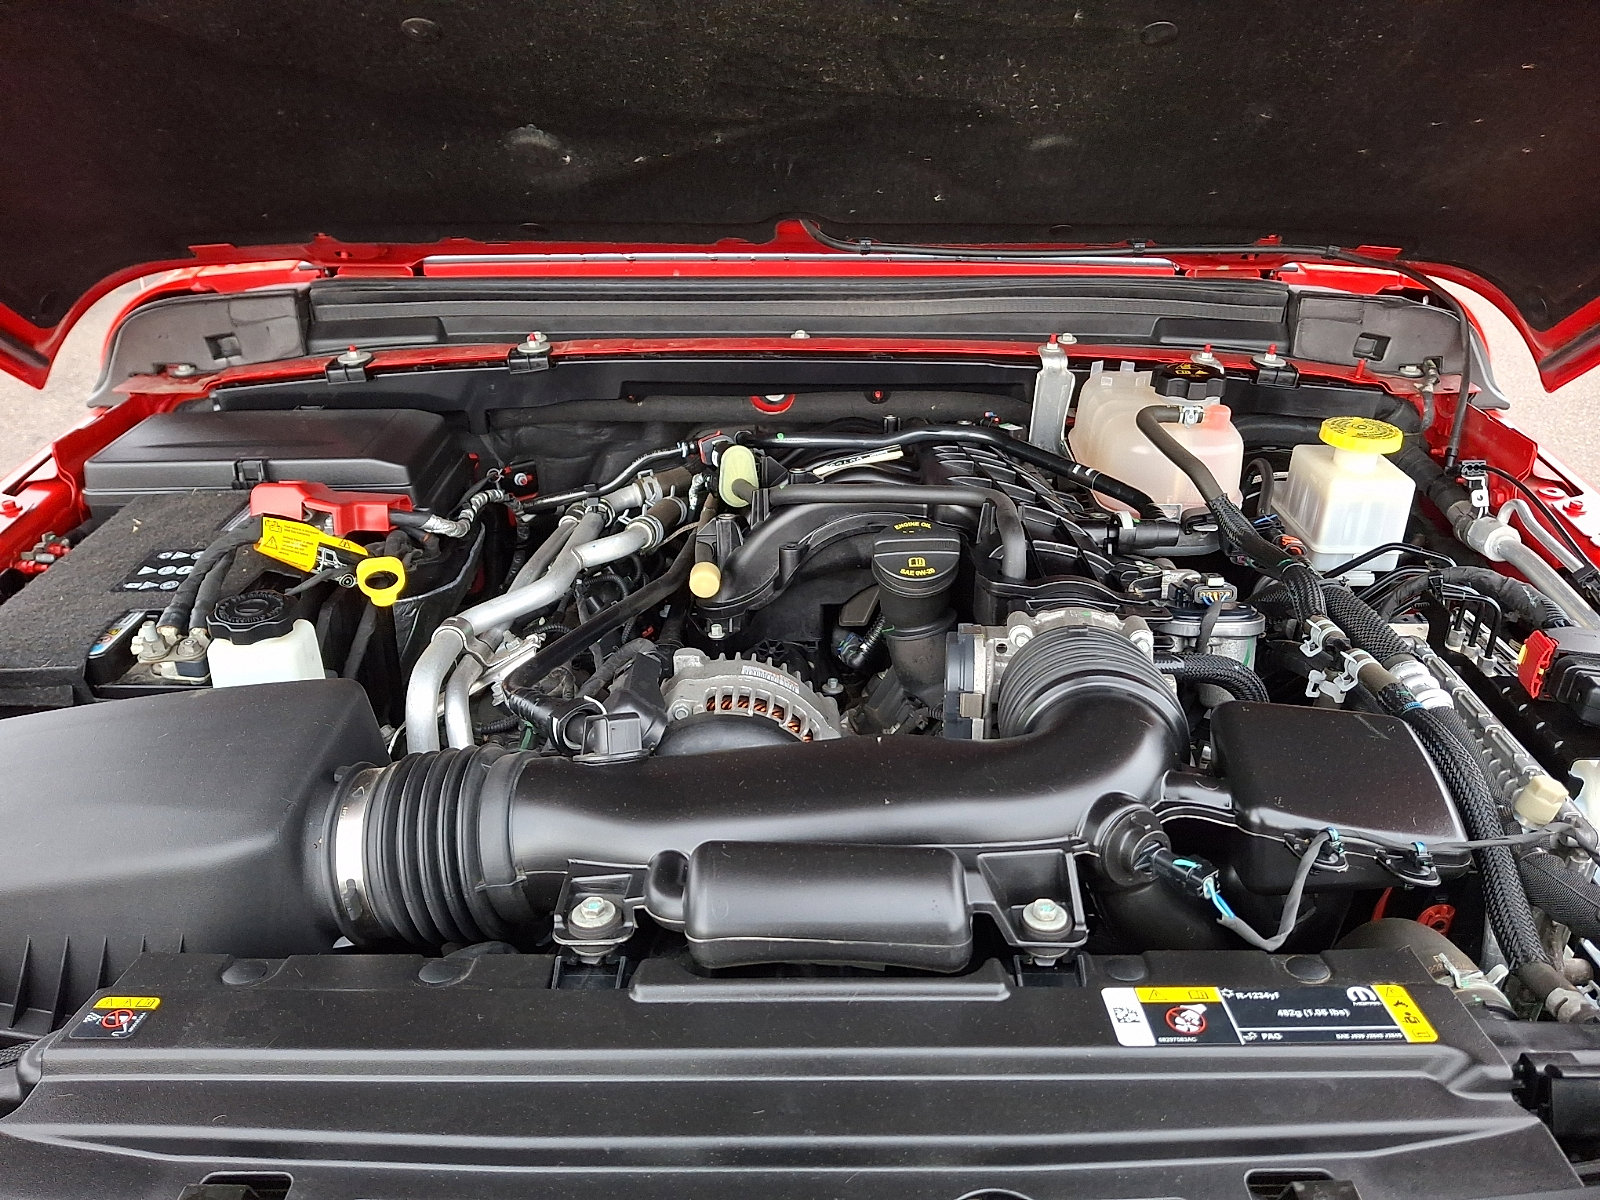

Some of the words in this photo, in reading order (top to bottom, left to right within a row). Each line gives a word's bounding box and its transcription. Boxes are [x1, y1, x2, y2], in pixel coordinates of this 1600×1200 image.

[894, 521, 920, 530] ENGINE
[900, 568, 914, 576] SAE
[1235, 991, 1280, 1000] R-1234yf
[1261, 1032, 1283, 1040] PAG
